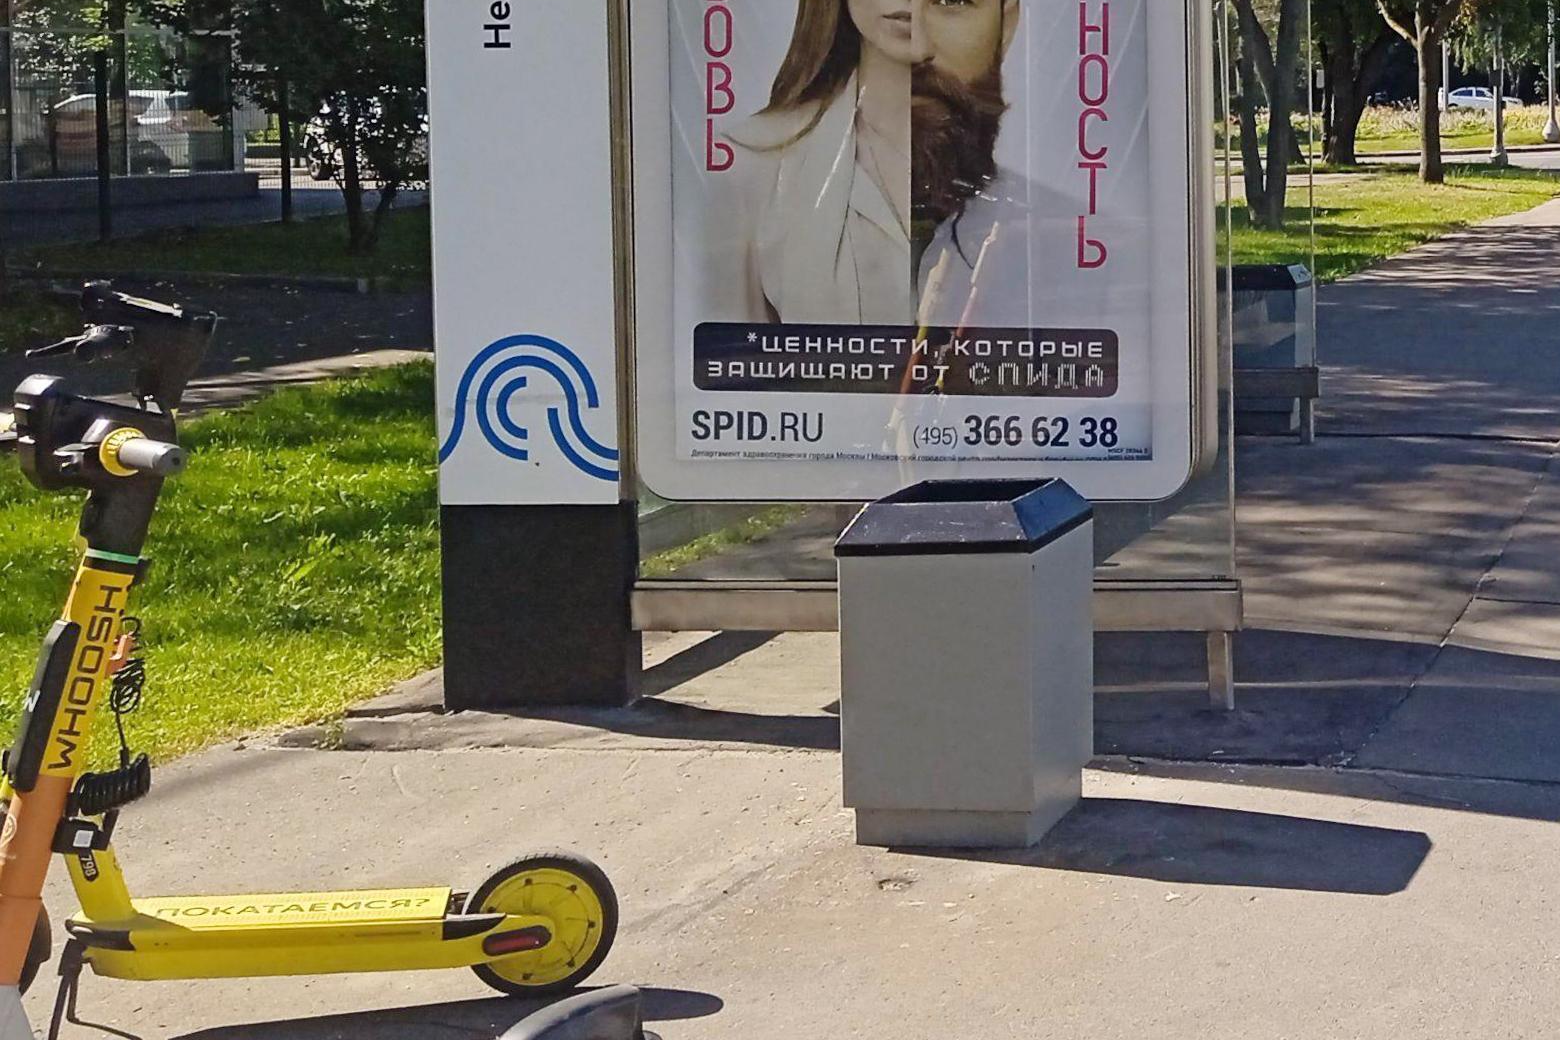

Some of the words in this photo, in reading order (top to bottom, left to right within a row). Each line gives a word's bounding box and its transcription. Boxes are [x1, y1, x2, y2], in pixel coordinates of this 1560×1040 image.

[954, 339, 1103, 359] КОТОРЫЕ
[708, 360, 896, 380] ЗАЩИЩАЮТ
[911, 365, 950, 381] ОТ
[968, 361, 1105, 390] СПИДА
[691, 410, 824, 443] SPID.RU
[913, 425, 959, 448] (495)
[963, 414, 1022, 447] 366
[1031, 416, 1070, 448] 62
[1079, 416, 1119, 448] 38
[48, 585, 122, 769] WHOOSH
[156, 898, 431, 917] ПОКАТАЕМСЯ?
